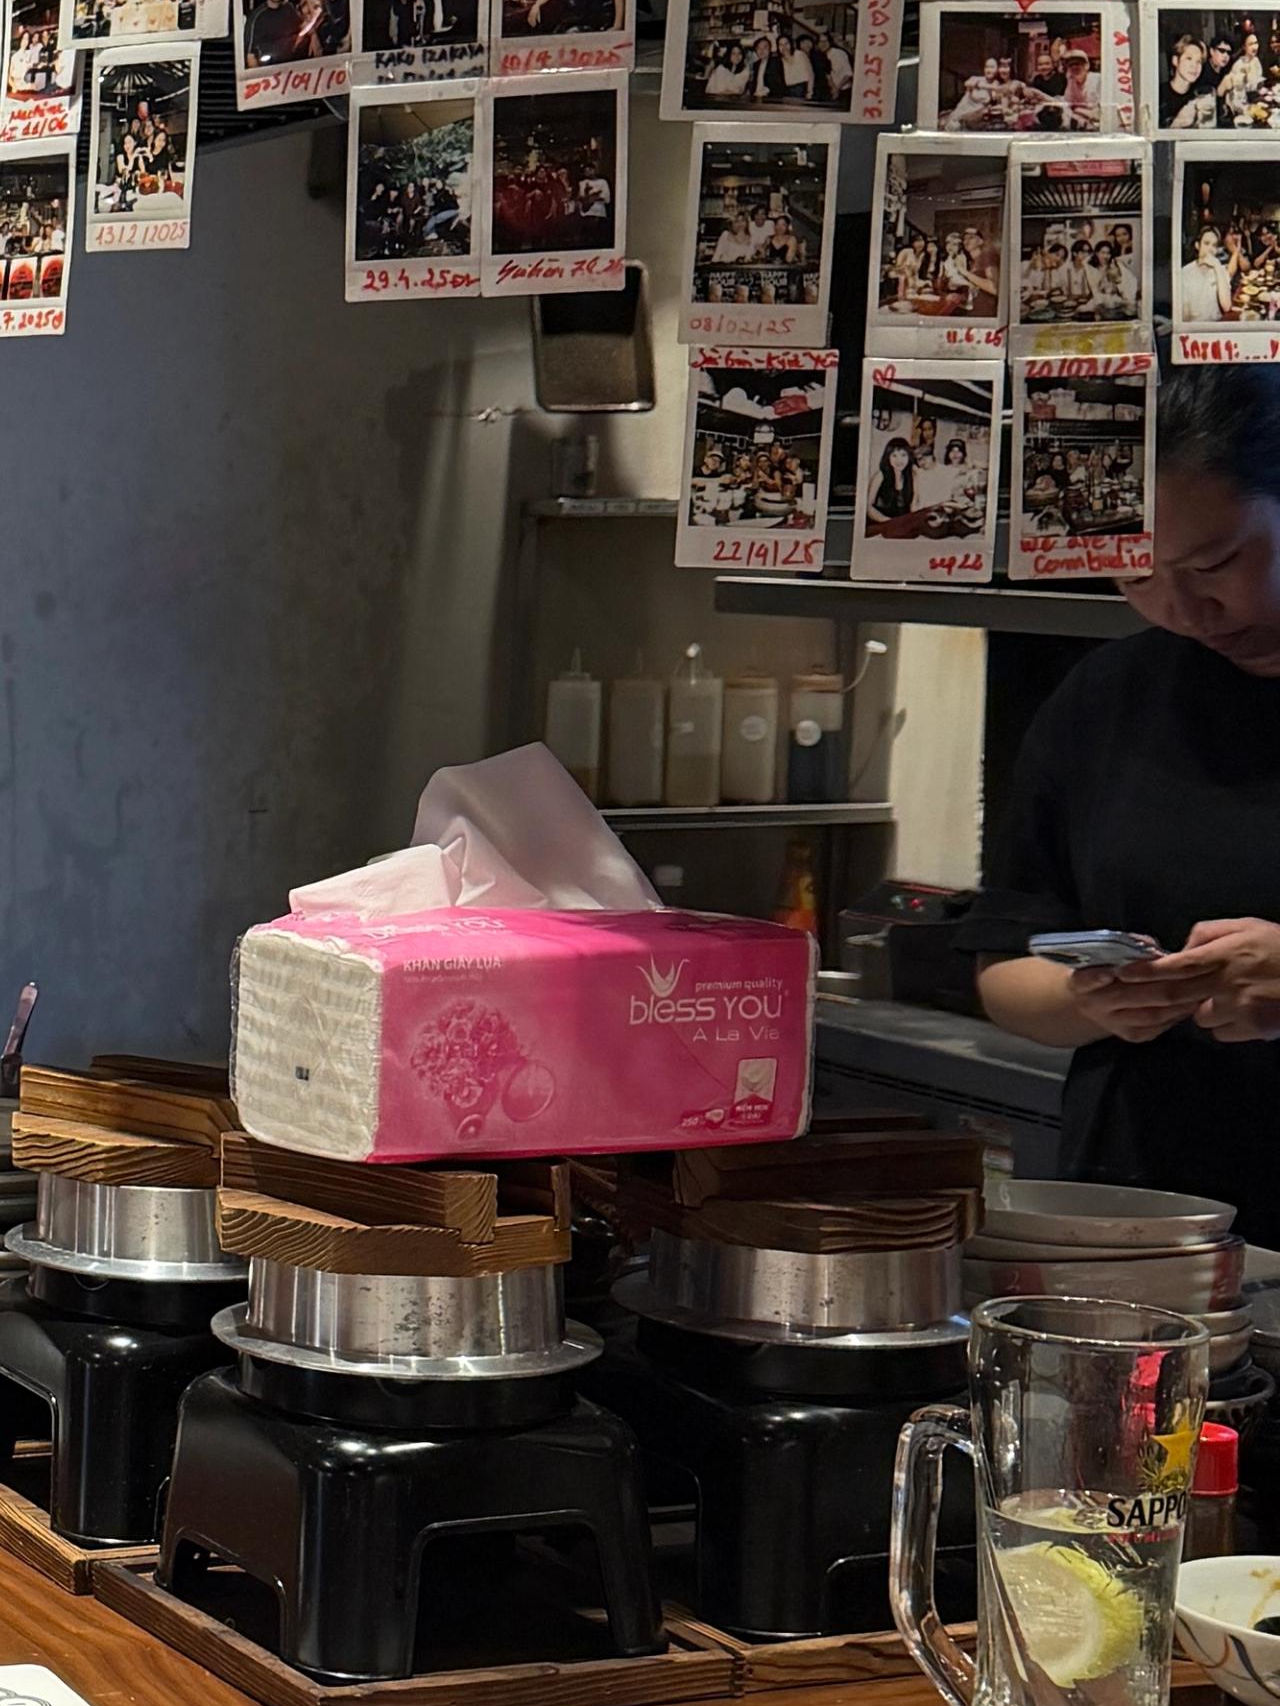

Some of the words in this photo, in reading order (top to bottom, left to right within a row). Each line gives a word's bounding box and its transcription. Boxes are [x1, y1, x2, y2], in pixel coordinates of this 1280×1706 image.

[695, 979, 742, 993] premium
[743, 976, 783, 992] quality
[630, 994, 713, 1026] bless
[719, 992, 783, 1020] YOU
[747, 1025, 783, 1042] Vie
